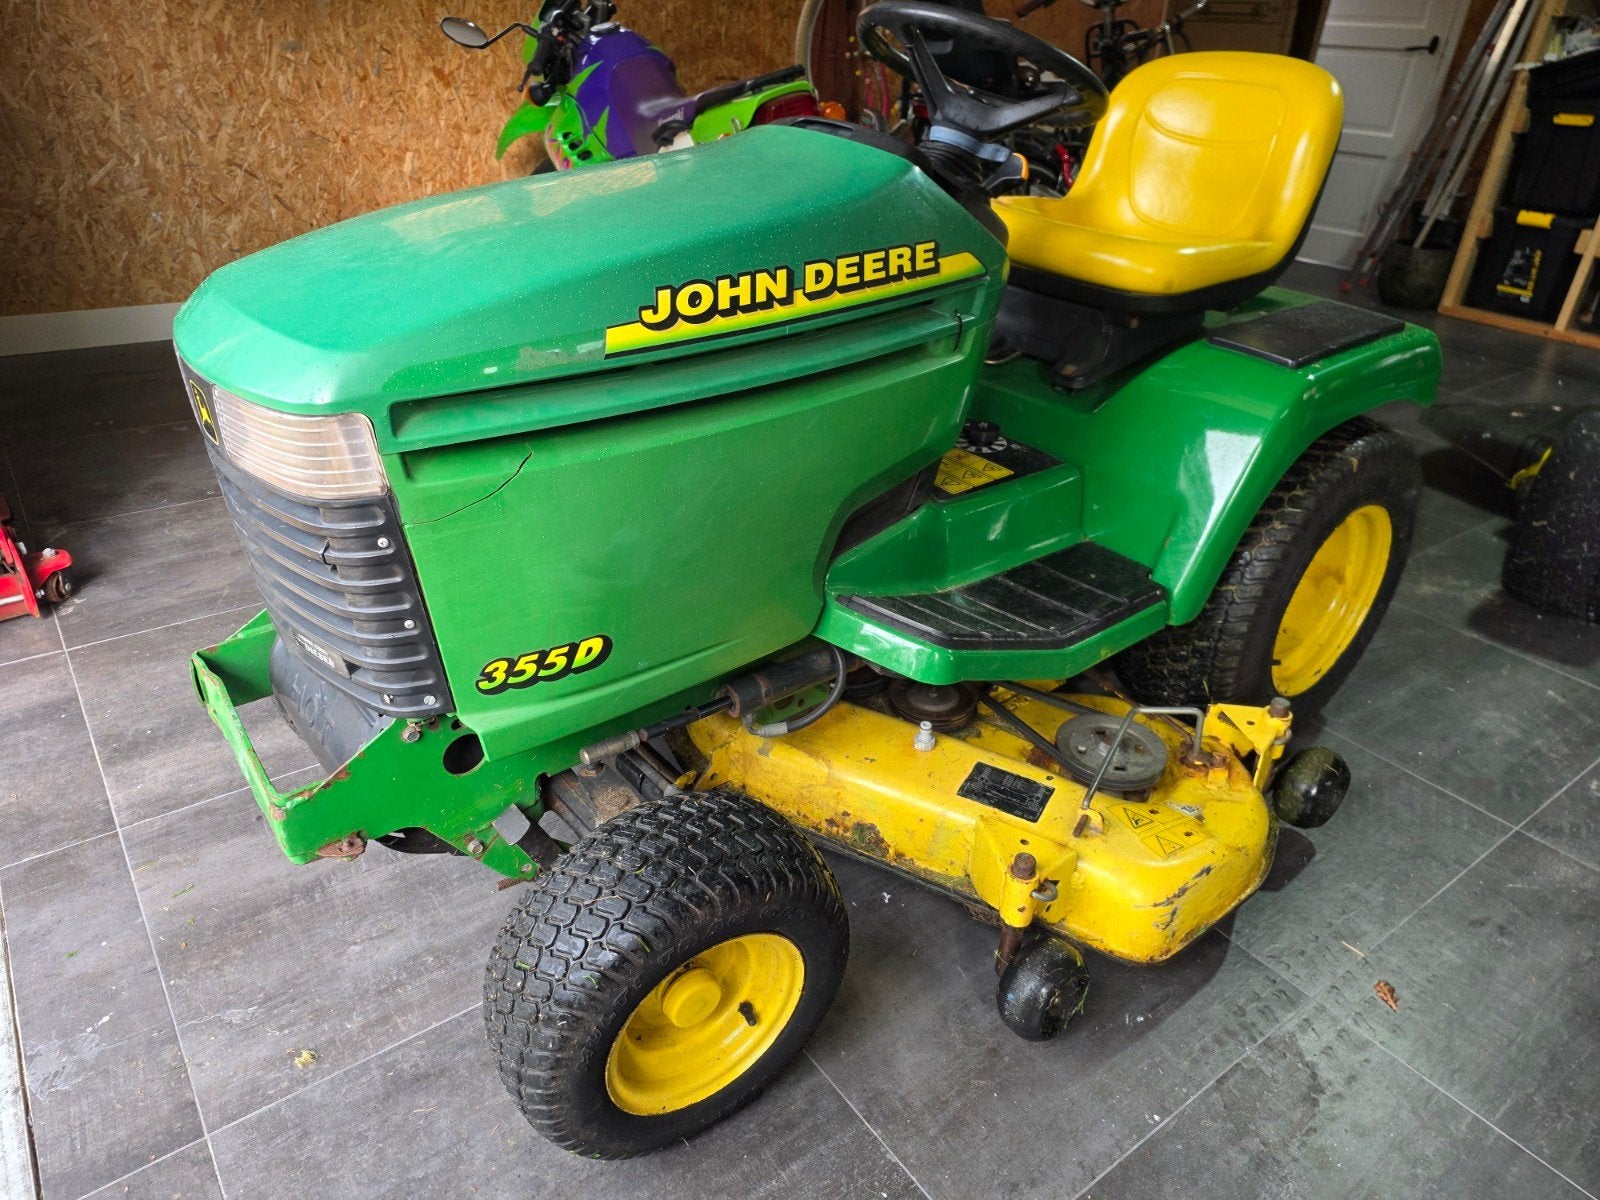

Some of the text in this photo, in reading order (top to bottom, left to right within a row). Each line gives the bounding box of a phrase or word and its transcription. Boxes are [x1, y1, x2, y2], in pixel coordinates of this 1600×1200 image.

[640, 240, 938, 329] JOHN DEERE
[476, 635, 612, 695] 355D
